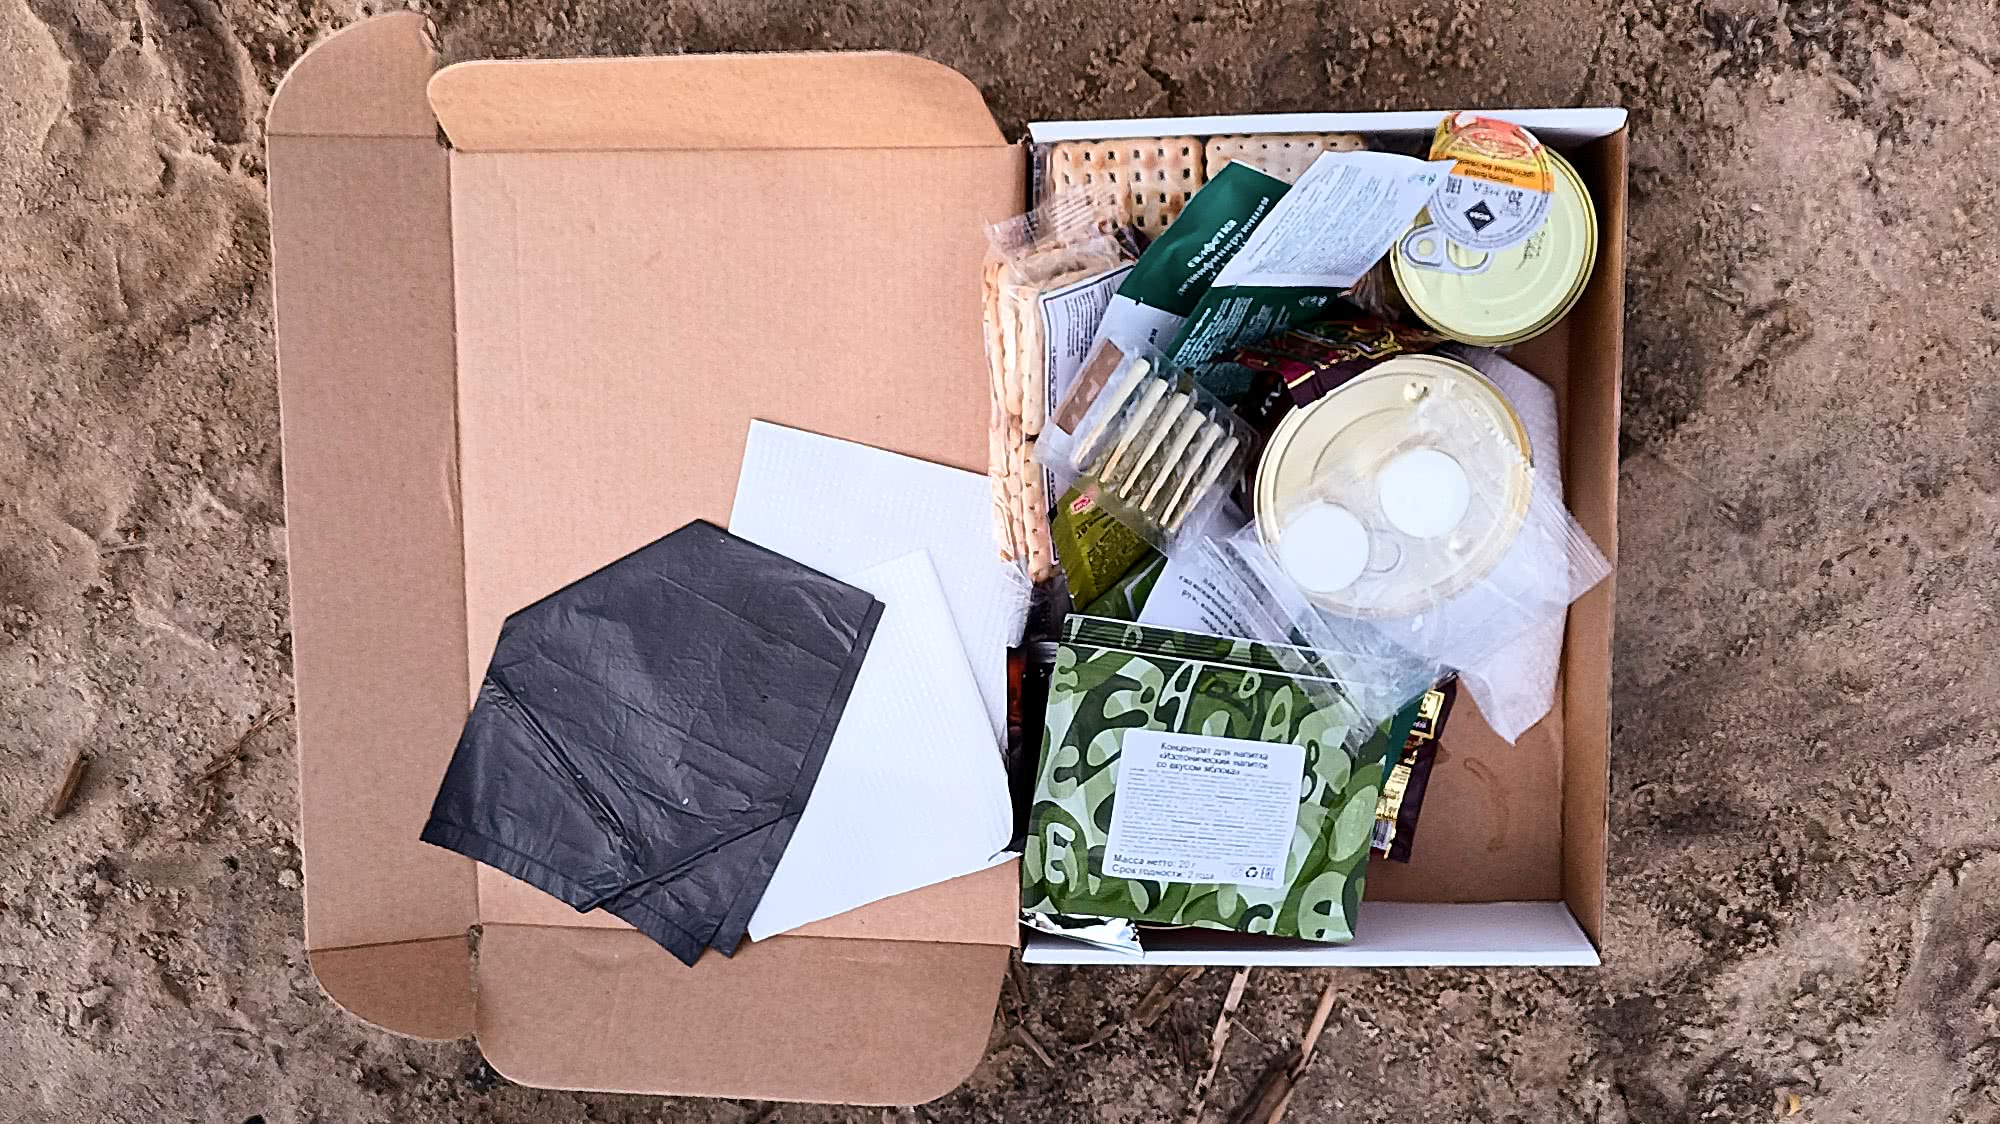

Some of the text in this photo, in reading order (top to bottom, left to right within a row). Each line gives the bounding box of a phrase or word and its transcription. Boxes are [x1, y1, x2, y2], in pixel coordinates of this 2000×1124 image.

[1160, 742, 1269, 761] Концентрат для напитка
[1156, 761, 1168, 769] со
[1169, 762, 1202, 772] вкусом
[1232, 760, 1269, 770] напиток
[1113, 853, 1145, 865] Масса
[1111, 863, 1137, 875] Срок
